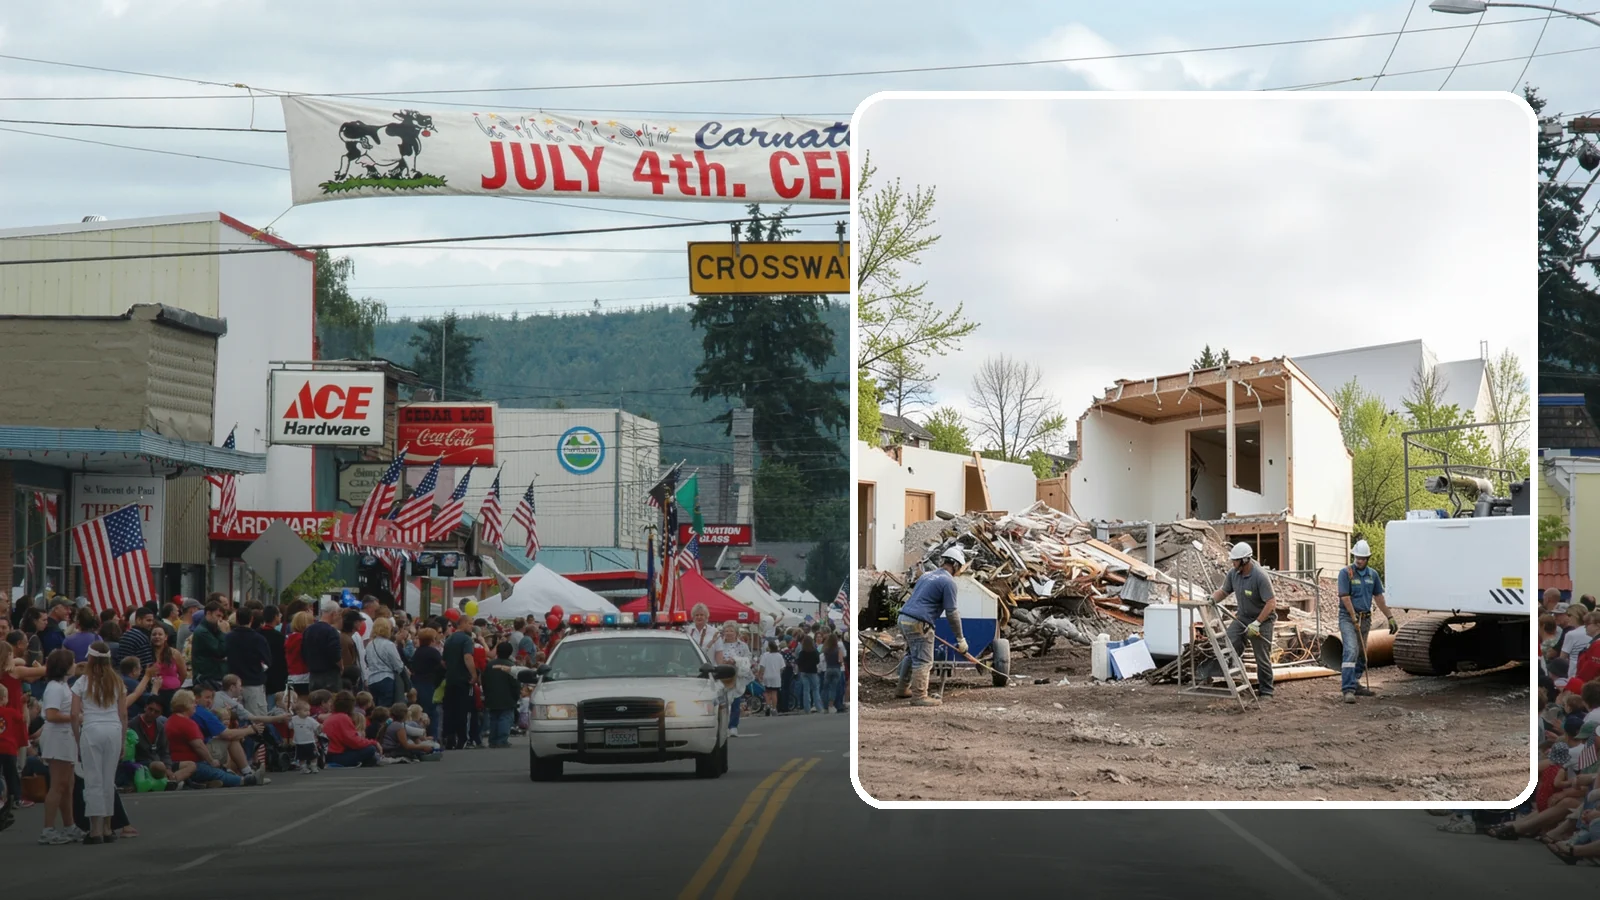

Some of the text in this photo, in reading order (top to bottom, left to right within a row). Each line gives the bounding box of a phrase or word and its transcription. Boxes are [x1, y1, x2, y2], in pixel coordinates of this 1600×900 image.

[481, 140, 604, 193] JULY
[632, 149, 746, 198] 4th.
[697, 254, 850, 280] CROSSWA
[283, 380, 373, 420] ACE
[405, 409, 485, 422] CEDAR LOG
[283, 421, 371, 436] Hardware
[416, 428, 477, 447] Coca-Cola
[353, 467, 385, 479] Simpl
[83, 484, 155, 495] St. Vincent de Paul
[81, 503, 154, 522] THRT
[688, 526, 741, 535] CRNATION
[699, 535, 730, 543] GLASS
